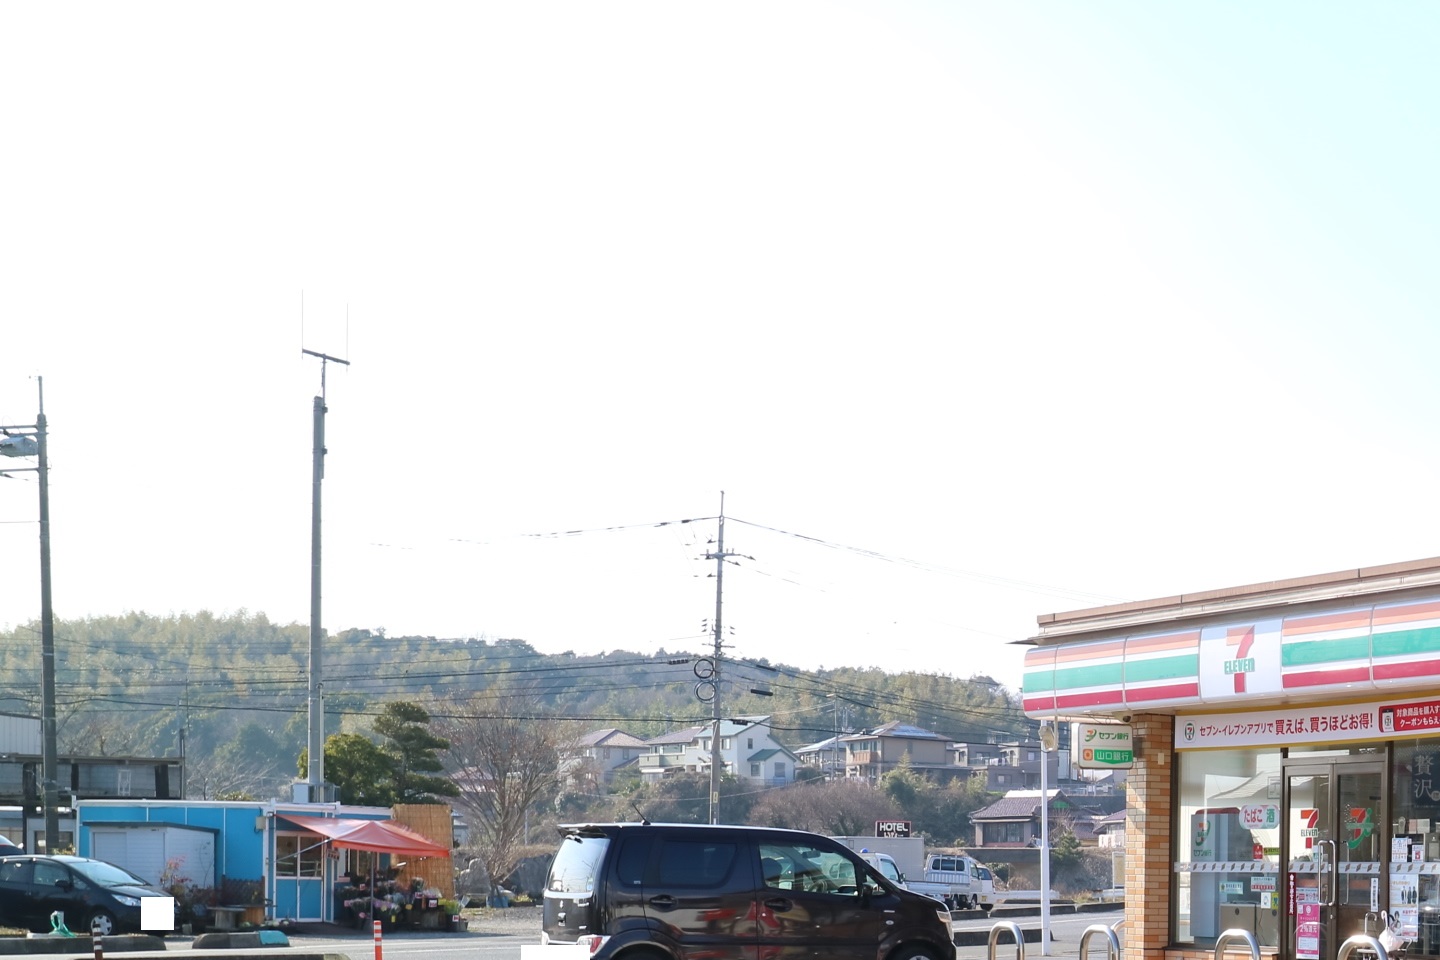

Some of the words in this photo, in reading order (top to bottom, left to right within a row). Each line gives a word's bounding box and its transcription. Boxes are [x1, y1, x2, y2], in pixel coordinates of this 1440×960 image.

[1098, 732, 1129, 741] セブン銀行
[1096, 751, 1129, 761] 山口銀行
[1243, 808, 1263, 823] たばこ
[1266, 808, 1275, 823] 酒
[879, 822, 909, 832] HOTEL
